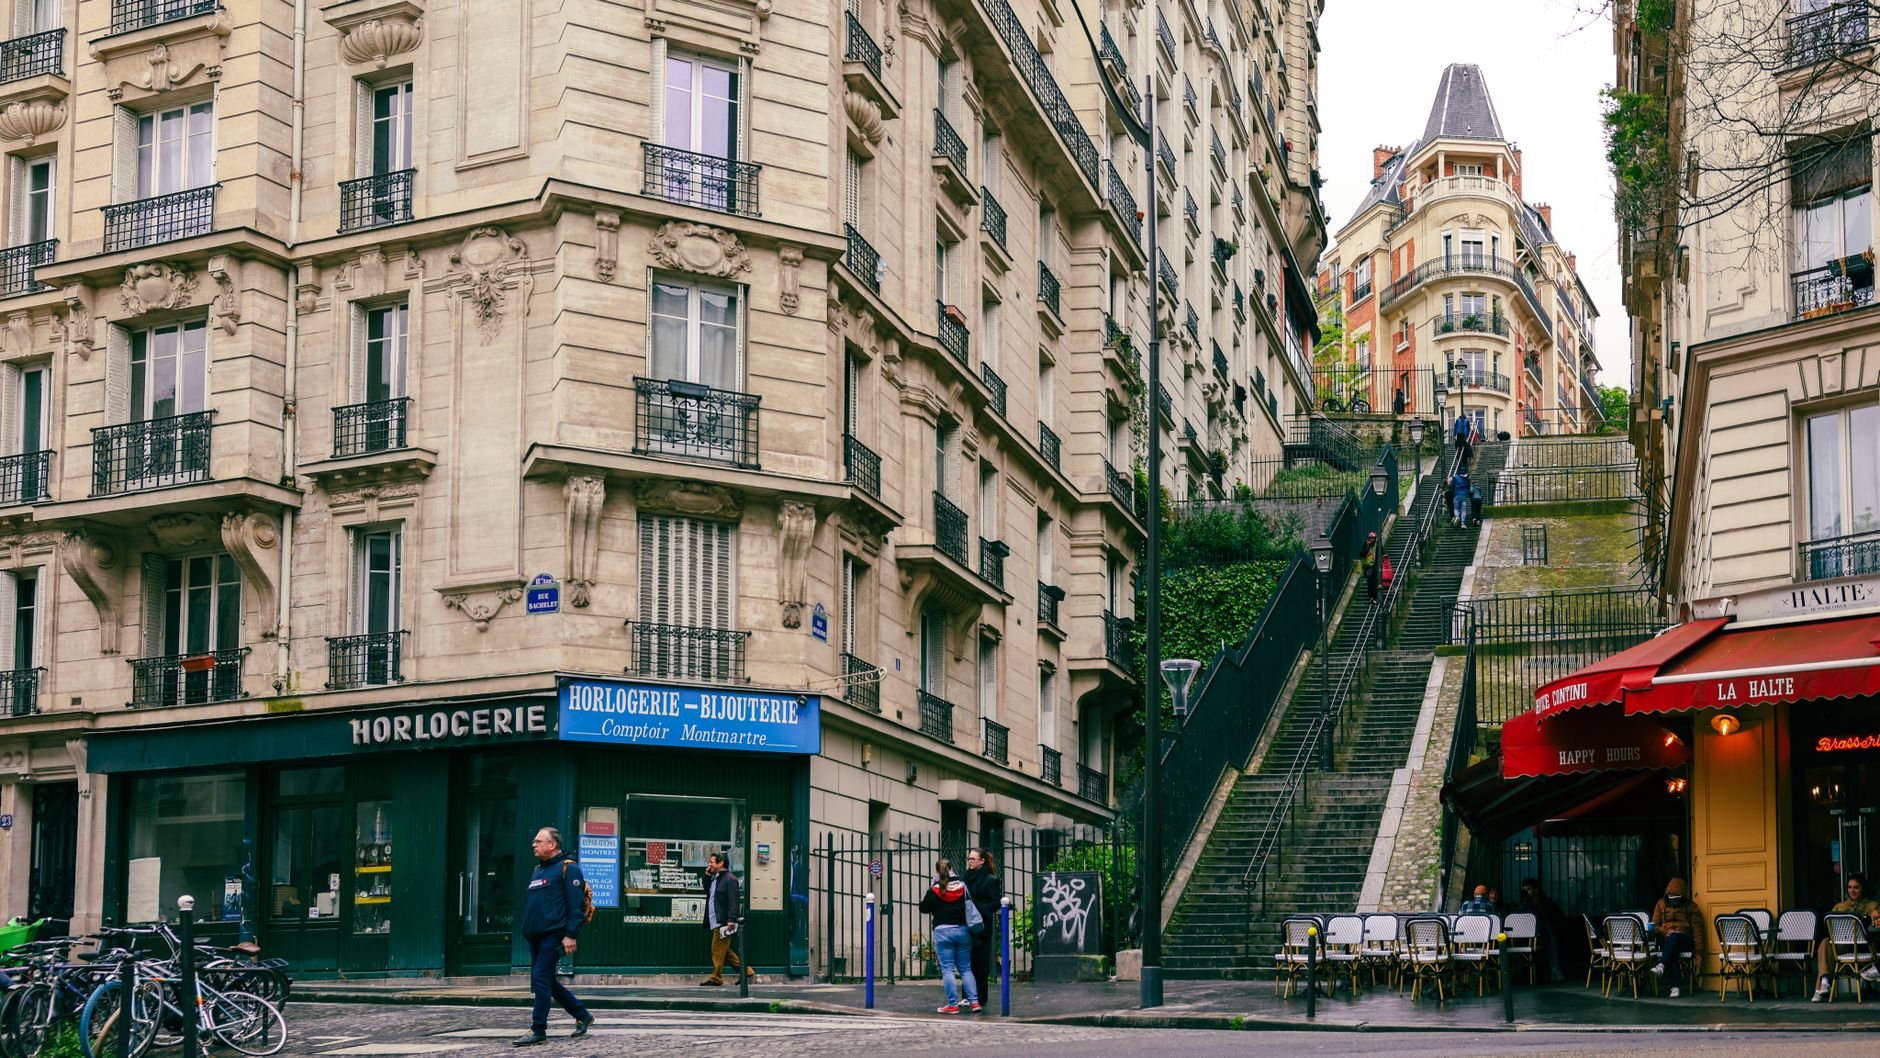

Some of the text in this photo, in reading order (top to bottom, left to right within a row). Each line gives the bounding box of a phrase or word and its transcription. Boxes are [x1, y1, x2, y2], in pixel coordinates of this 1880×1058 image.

[528, 601, 558, 609] BACHELET
[538, 592, 549, 600] RUE
[1791, 584, 1865, 607] HALTE
[1552, 682, 1588, 706] CONTINU
[1718, 677, 1794, 701] LA HALTE
[568, 685, 680, 716] HORLOGERIE
[700, 694, 799, 724] BIJOUTERIE
[601, 718, 767, 746] Comptoir Montmartre
[1558, 746, 1641, 766] HAPPY HOURS
